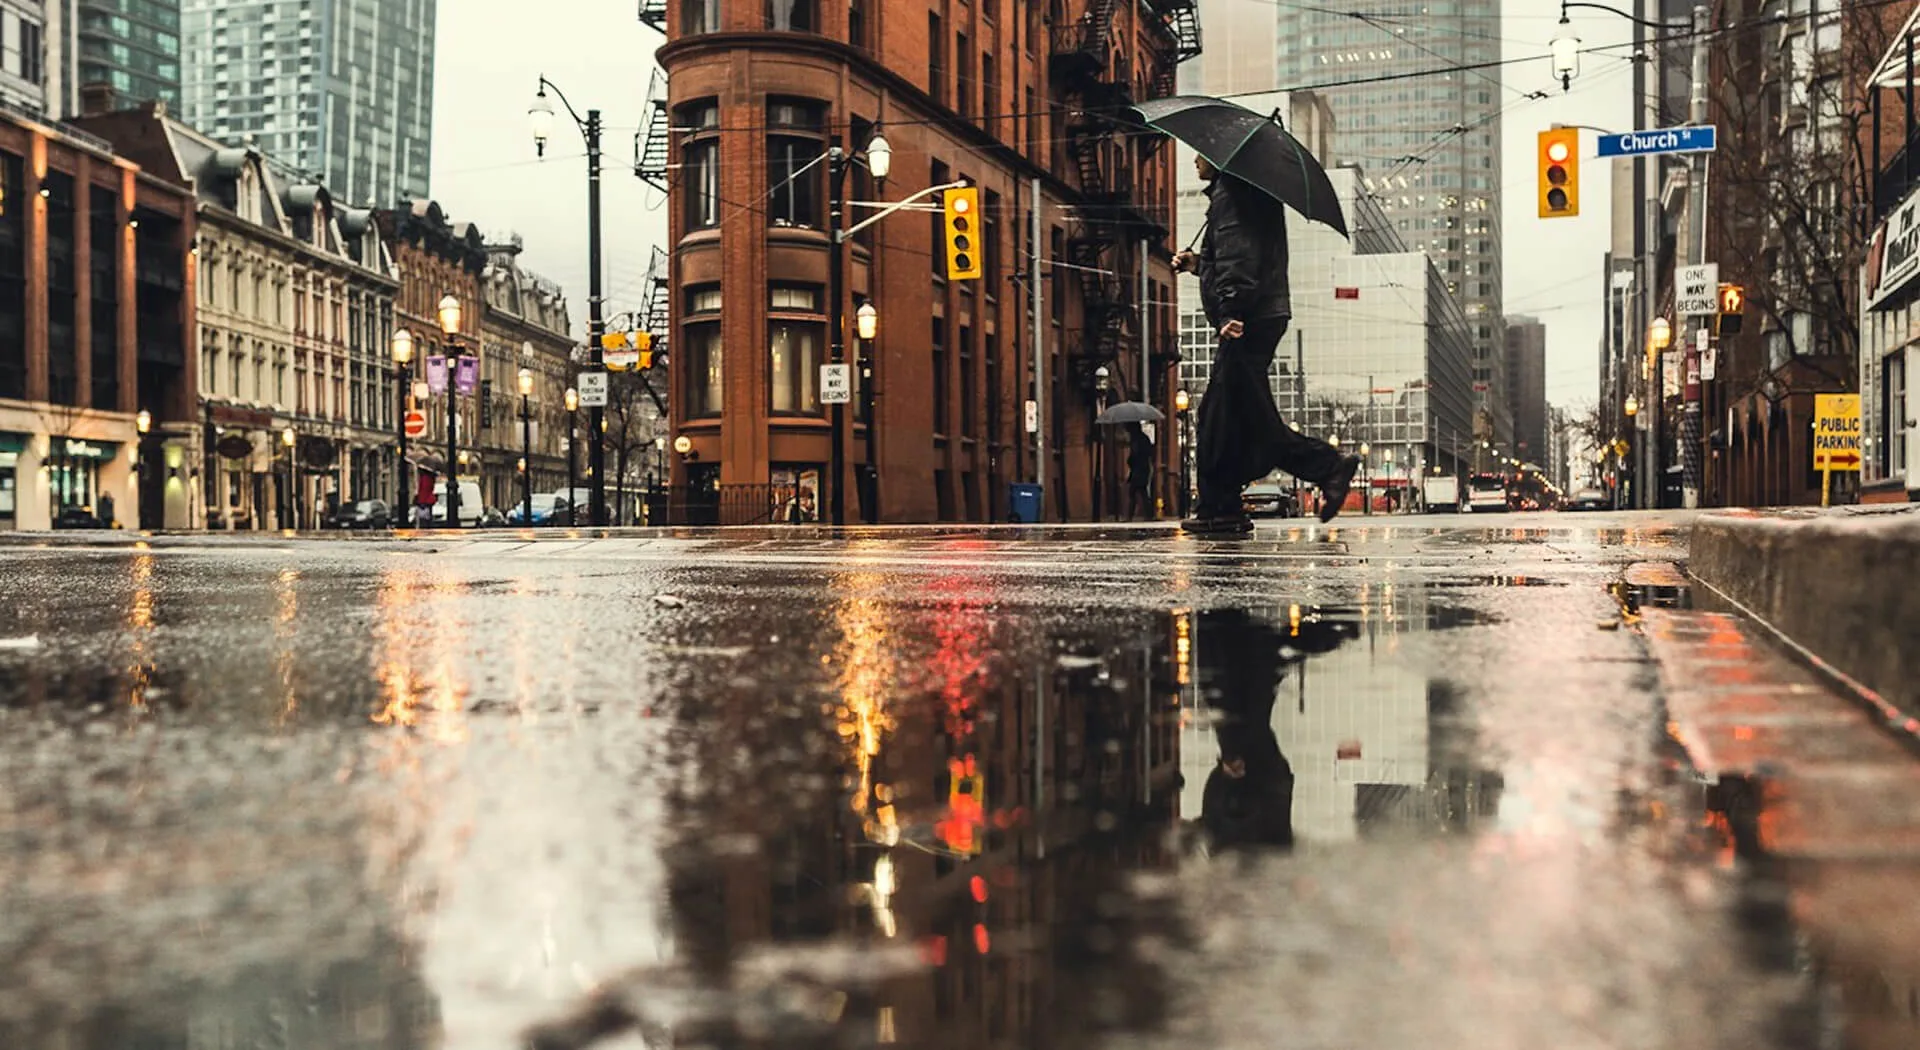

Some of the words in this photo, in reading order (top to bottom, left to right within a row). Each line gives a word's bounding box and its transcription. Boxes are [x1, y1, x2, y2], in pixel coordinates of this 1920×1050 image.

[1620, 130, 1678, 151] Church
[1686, 270, 1706, 281] ONE
[1686, 284, 1706, 296] WAY
[1677, 299, 1716, 312] BEGINS
[1820, 417, 1860, 432] PUBLIC
